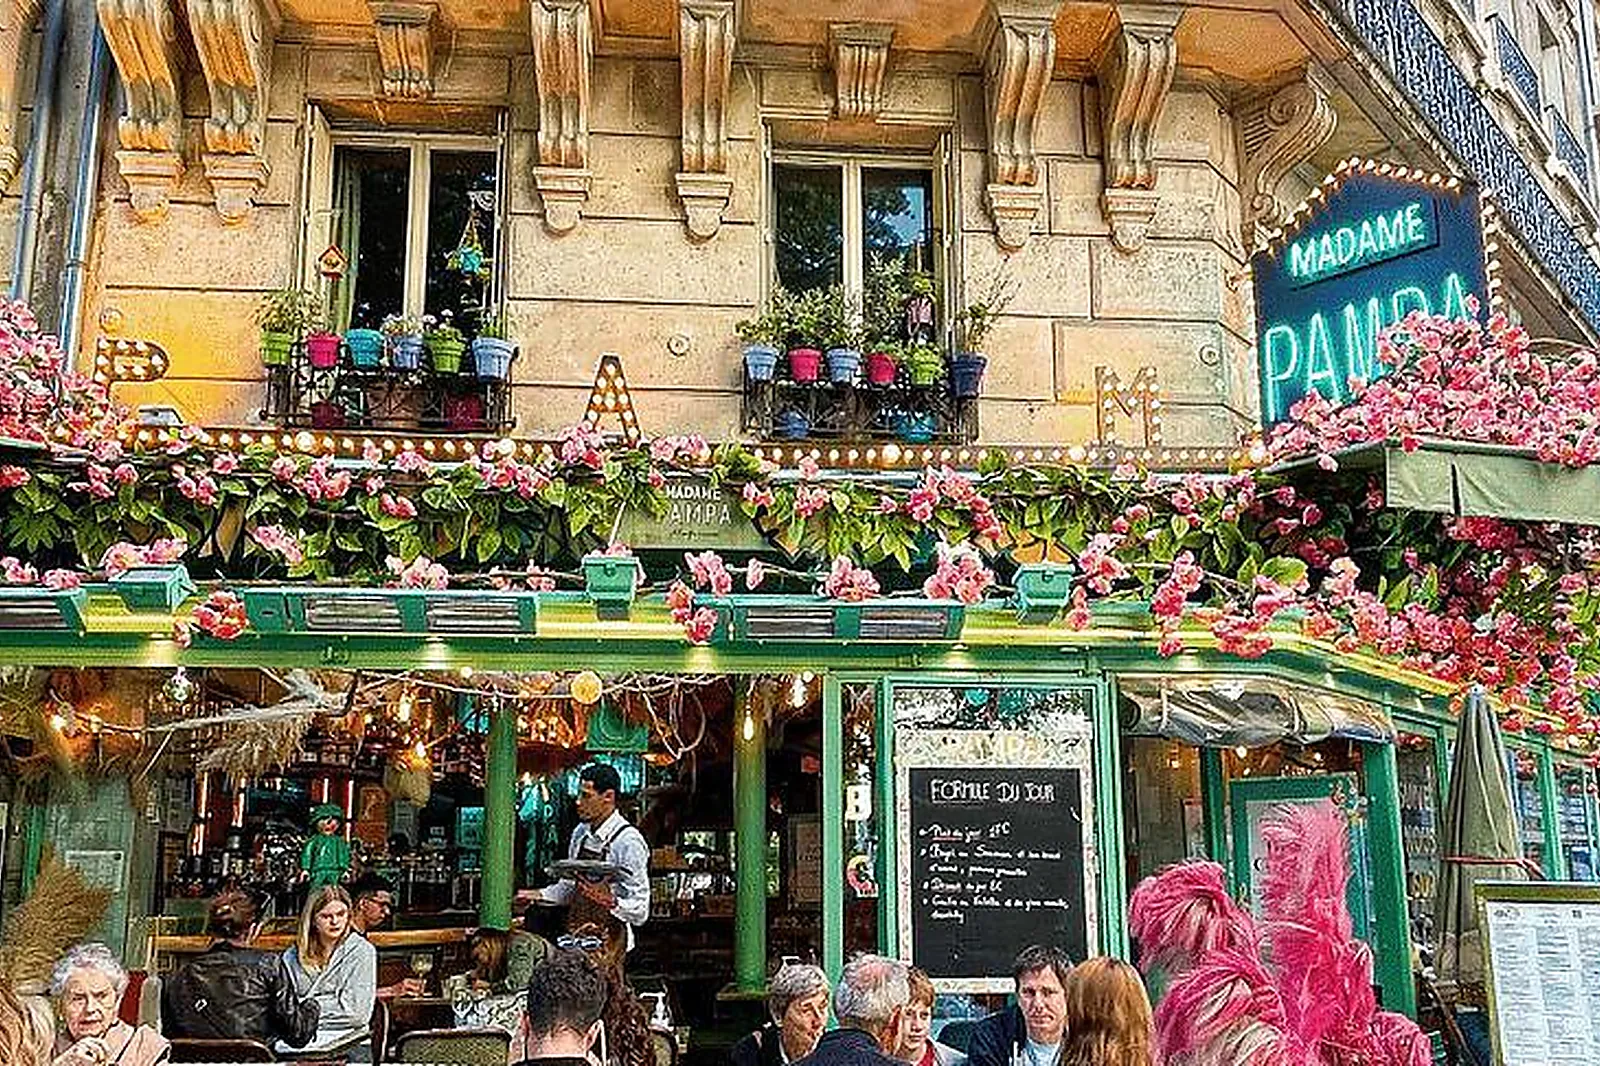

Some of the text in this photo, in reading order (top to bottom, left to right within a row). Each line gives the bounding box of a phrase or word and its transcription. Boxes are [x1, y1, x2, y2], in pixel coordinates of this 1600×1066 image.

[1289, 203, 1425, 277] MADAME
[996, 781, 1020, 803] DU
[1023, 782, 1056, 803] JOUR
